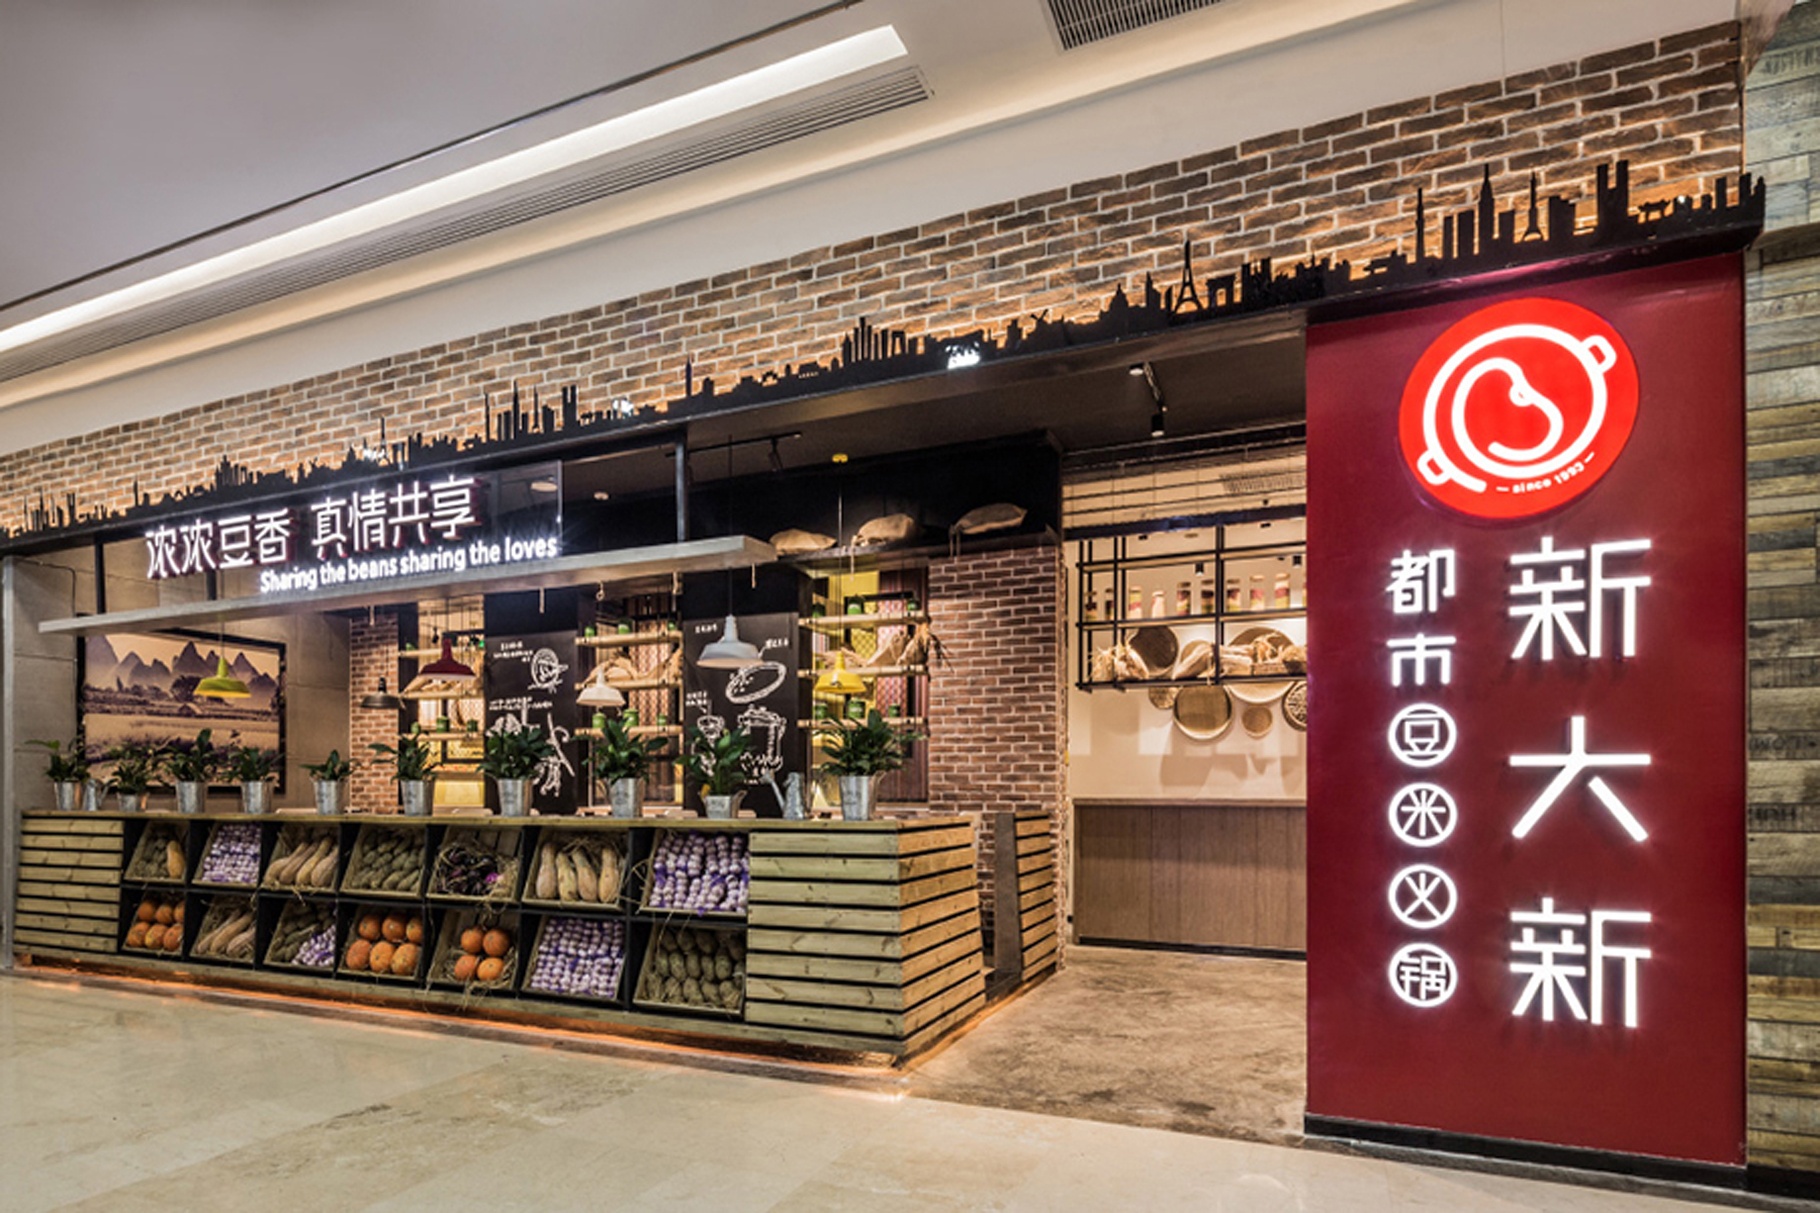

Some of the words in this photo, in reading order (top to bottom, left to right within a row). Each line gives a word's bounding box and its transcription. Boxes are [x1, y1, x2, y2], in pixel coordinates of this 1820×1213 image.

[145, 507, 292, 580] 浓浓豆香
[310, 473, 476, 561] 真情共享
[260, 566, 318, 594] Sharing
[319, 561, 346, 585] the
[347, 557, 399, 581] beans
[400, 546, 467, 575] sharing
[468, 540, 500, 566] the
[504, 536, 558, 562] loves
[1385, 548, 1458, 1009] 都市豆米火锅
[1508, 535, 1652, 1028] 新大新
